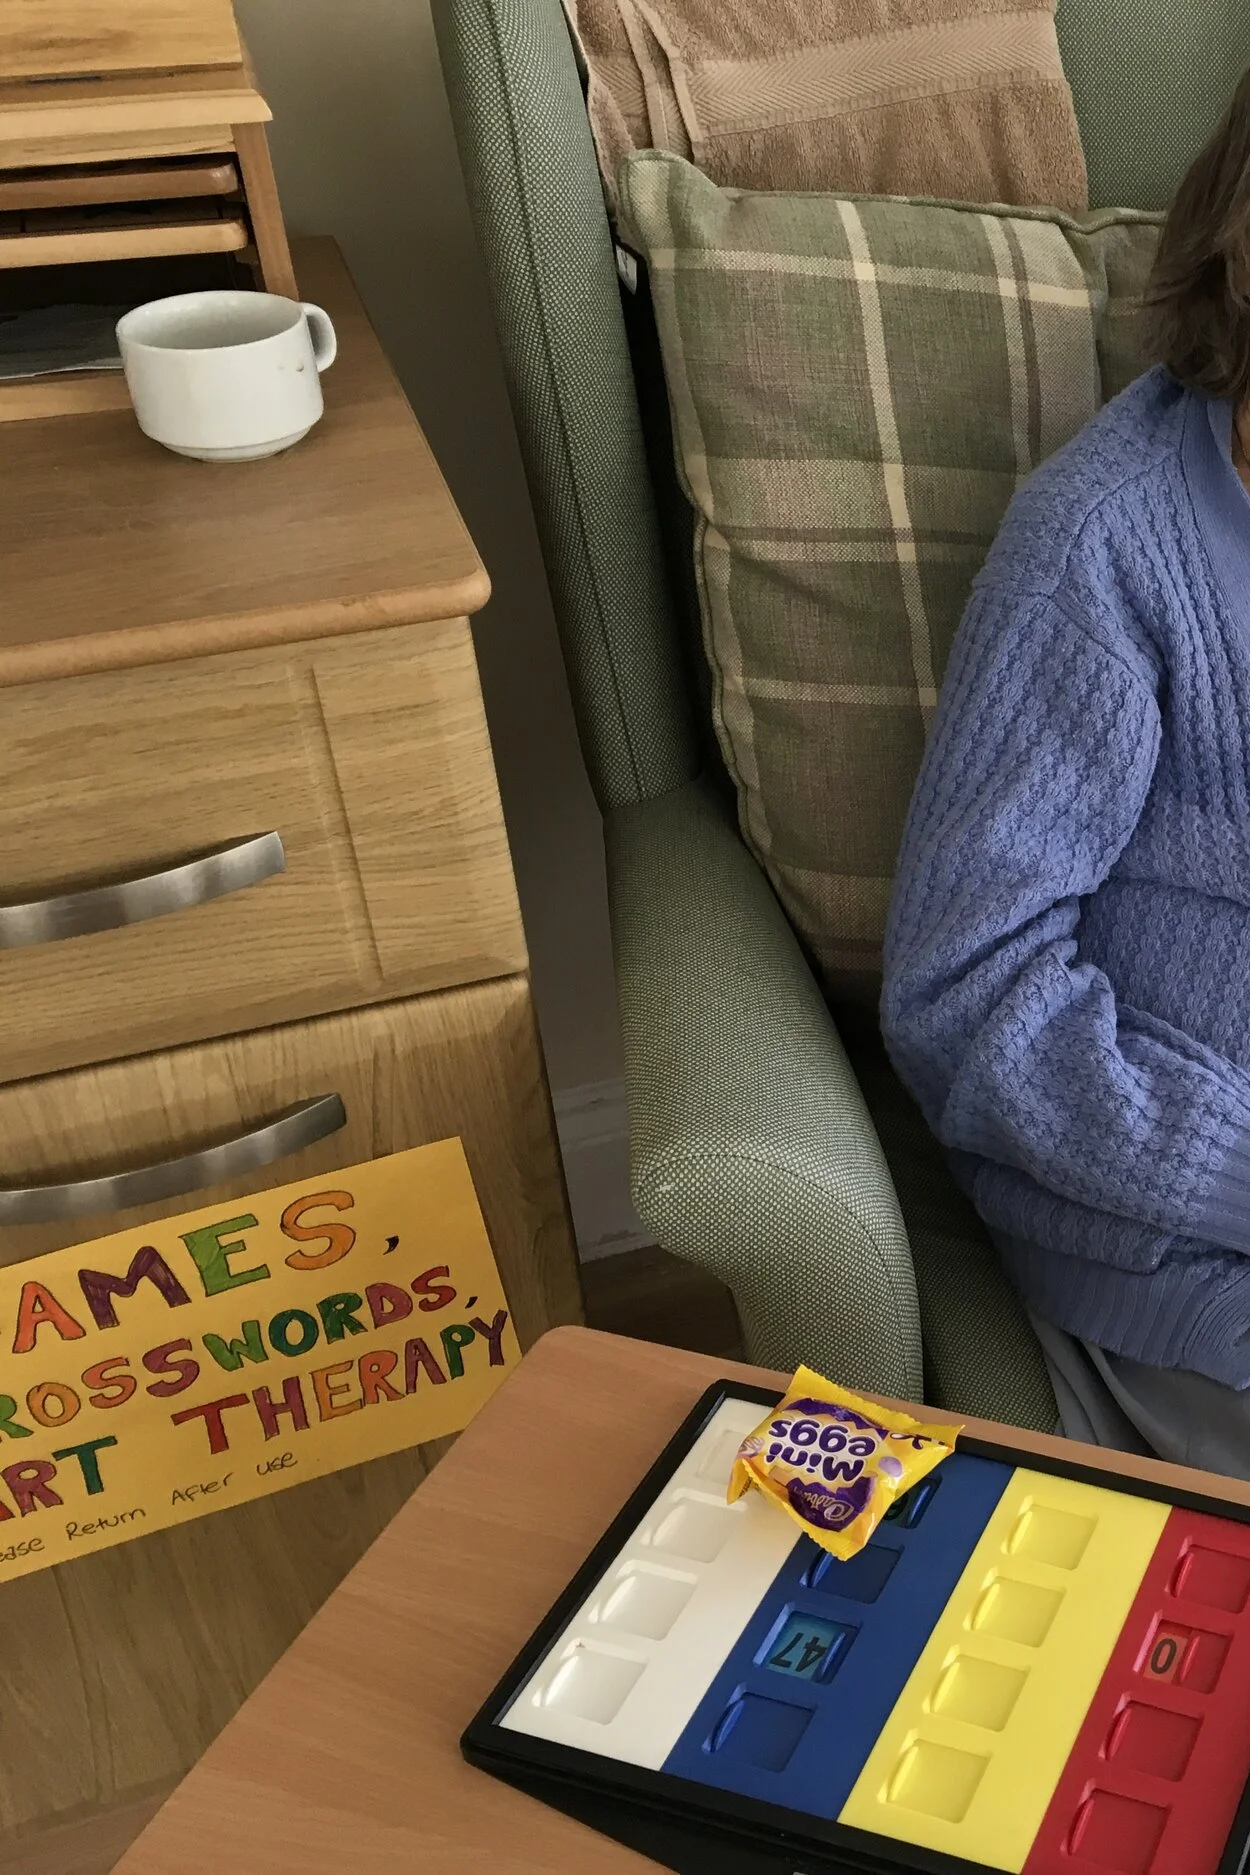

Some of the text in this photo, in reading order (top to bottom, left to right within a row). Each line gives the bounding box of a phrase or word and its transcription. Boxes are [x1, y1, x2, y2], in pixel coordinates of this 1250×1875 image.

[0, 1191, 400, 1353] AMES,
[0, 1309, 508, 1521] RT THERAPY
[768, 1419, 876, 1457] eggs
[766, 1442, 864, 1482] Mini
[65, 1507, 146, 1541] Return
[171, 1472, 233, 1505] After
[256, 1452, 298, 1476] use
[793, 1486, 855, 1521] Cadbu
[769, 1632, 827, 1672] 47
[1150, 1637, 1177, 1674] 0
